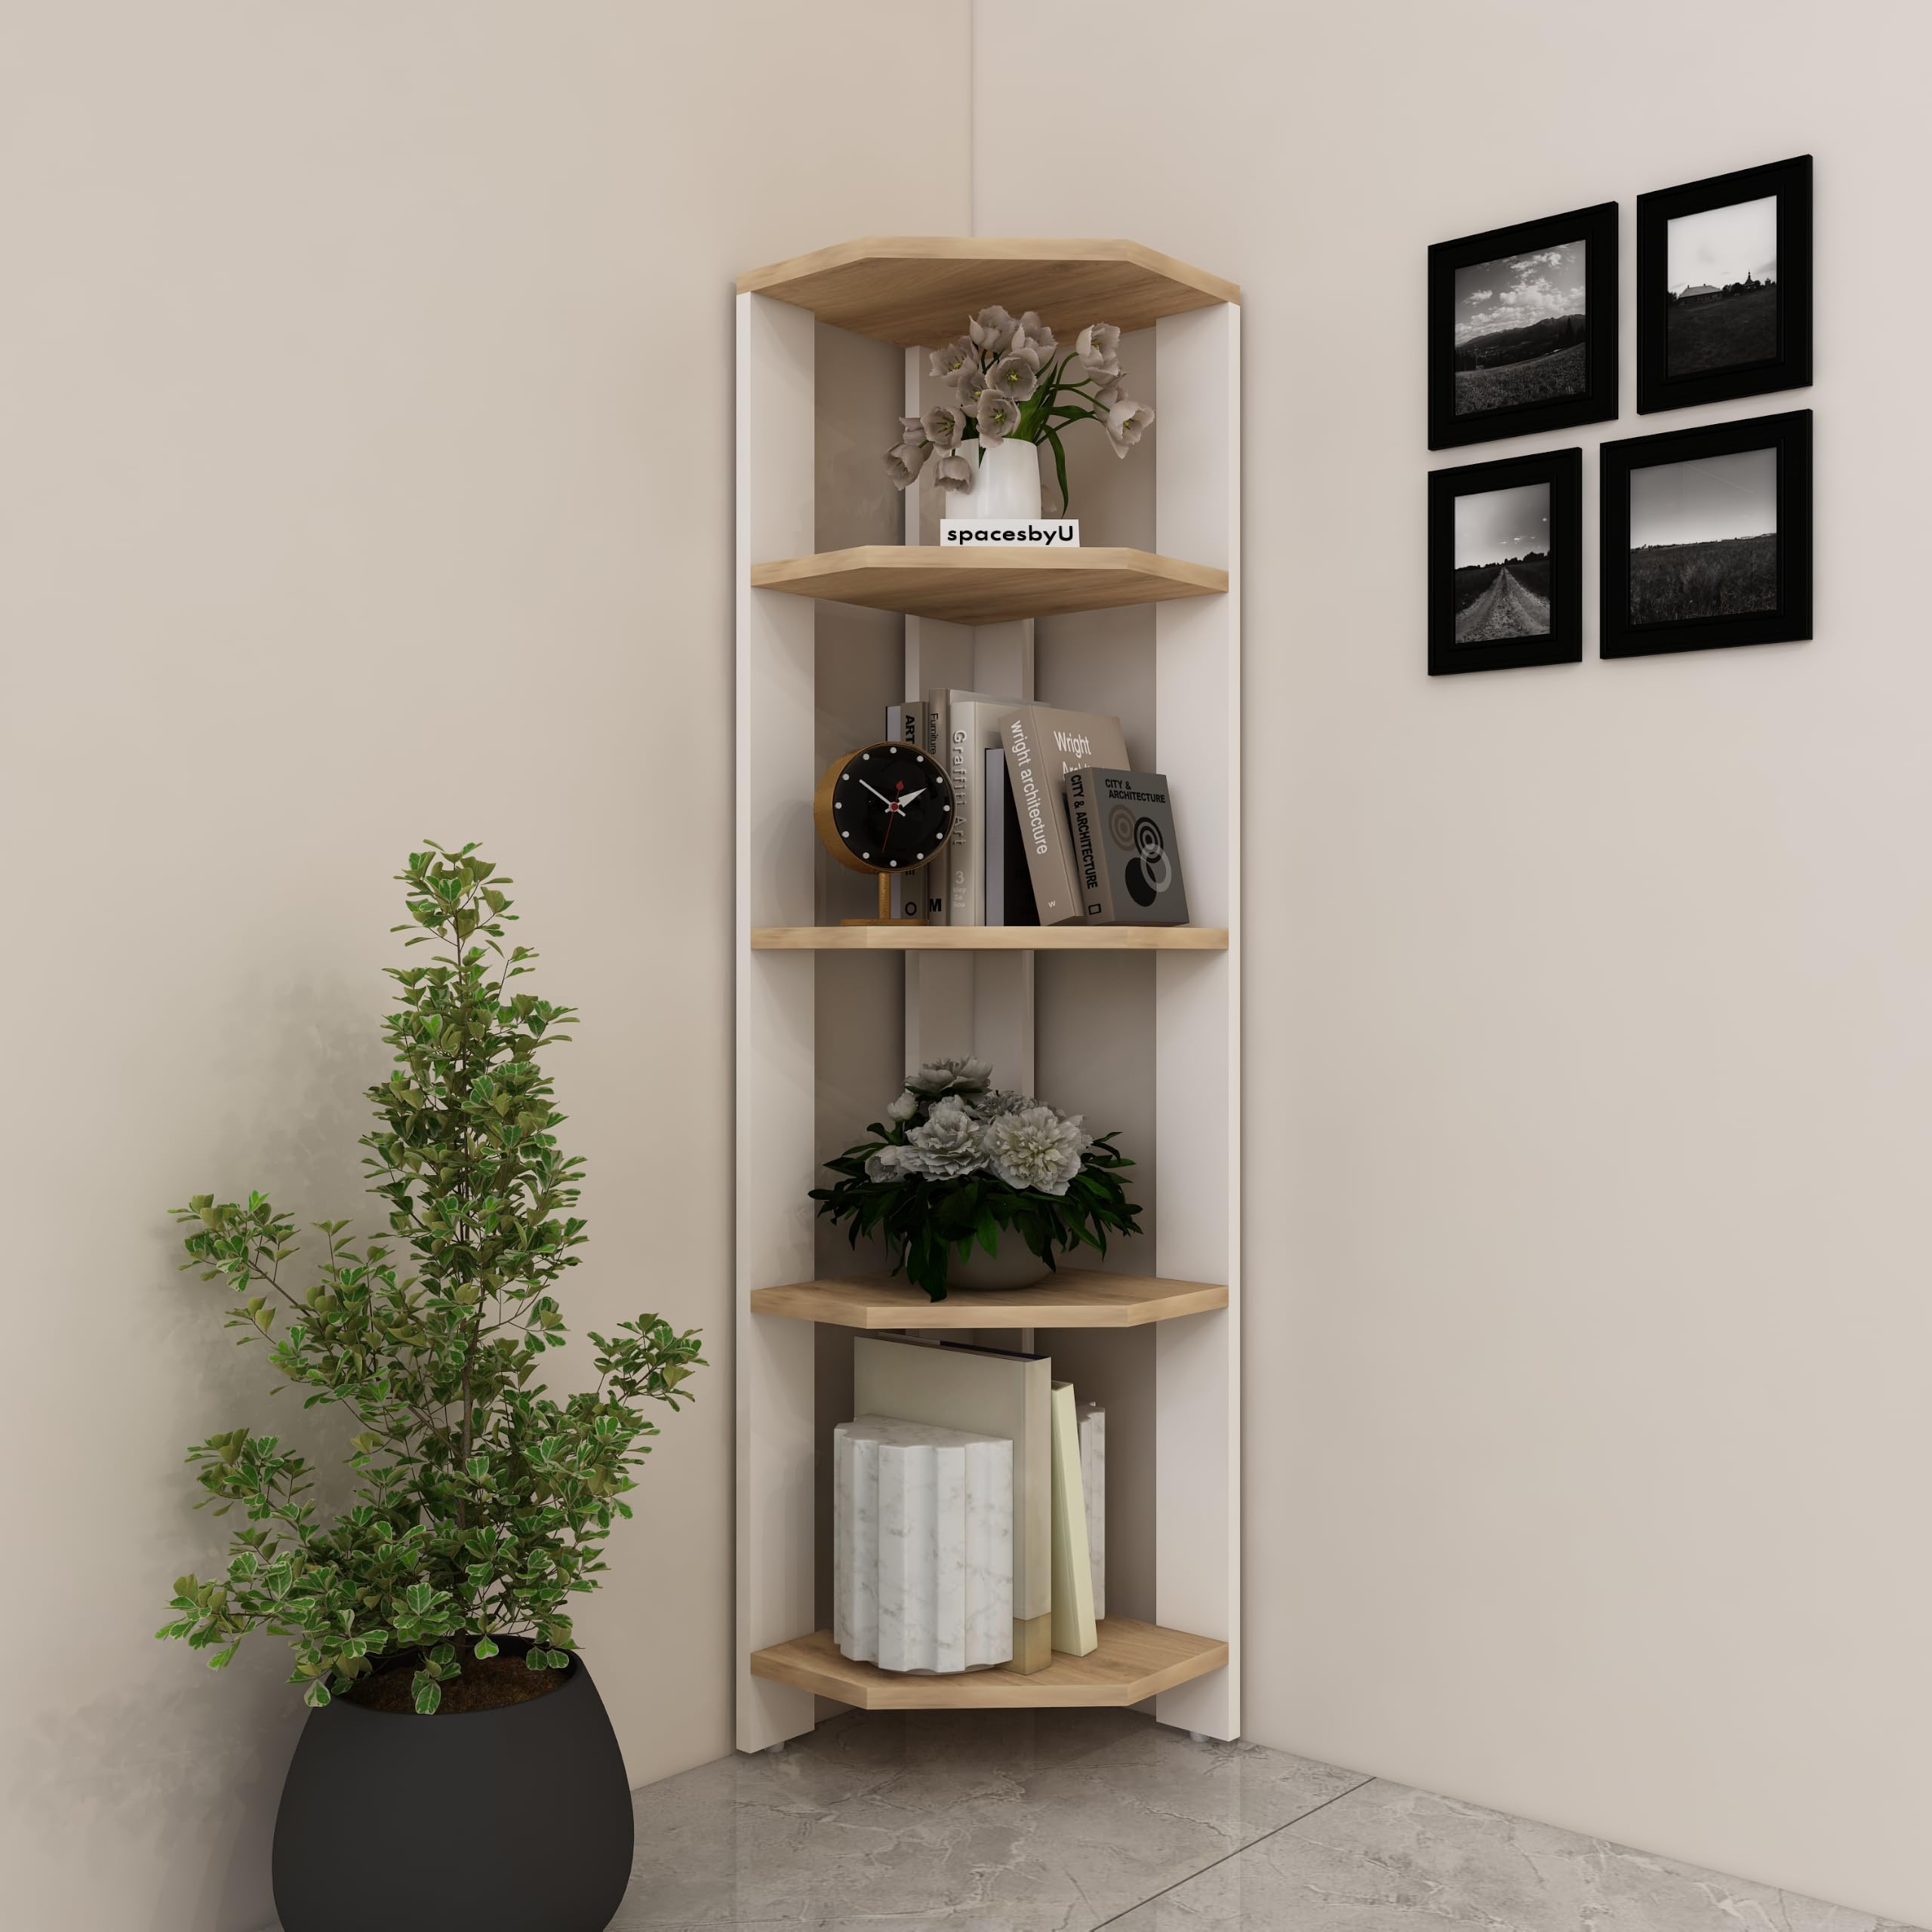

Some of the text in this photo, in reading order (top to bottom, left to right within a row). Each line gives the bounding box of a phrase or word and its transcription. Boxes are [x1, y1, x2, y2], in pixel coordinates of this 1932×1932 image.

[947, 525, 1073, 545] spacesbyU
[906, 715, 915, 744] ART
[930, 712, 939, 755] Furniture
[1054, 731, 1091, 758] Wright
[952, 730, 966, 845] Graffiti Art
[1011, 720, 1048, 854] wright architecture
[1071, 774, 1084, 798] CITY
[1105, 779, 1131, 789] CITY &
[1109, 789, 1166, 803] ARCHITECTURE
[1076, 812, 1098, 889] ARCHITECTURE
[955, 871, 964, 884] 3
[930, 899, 942, 912] M
